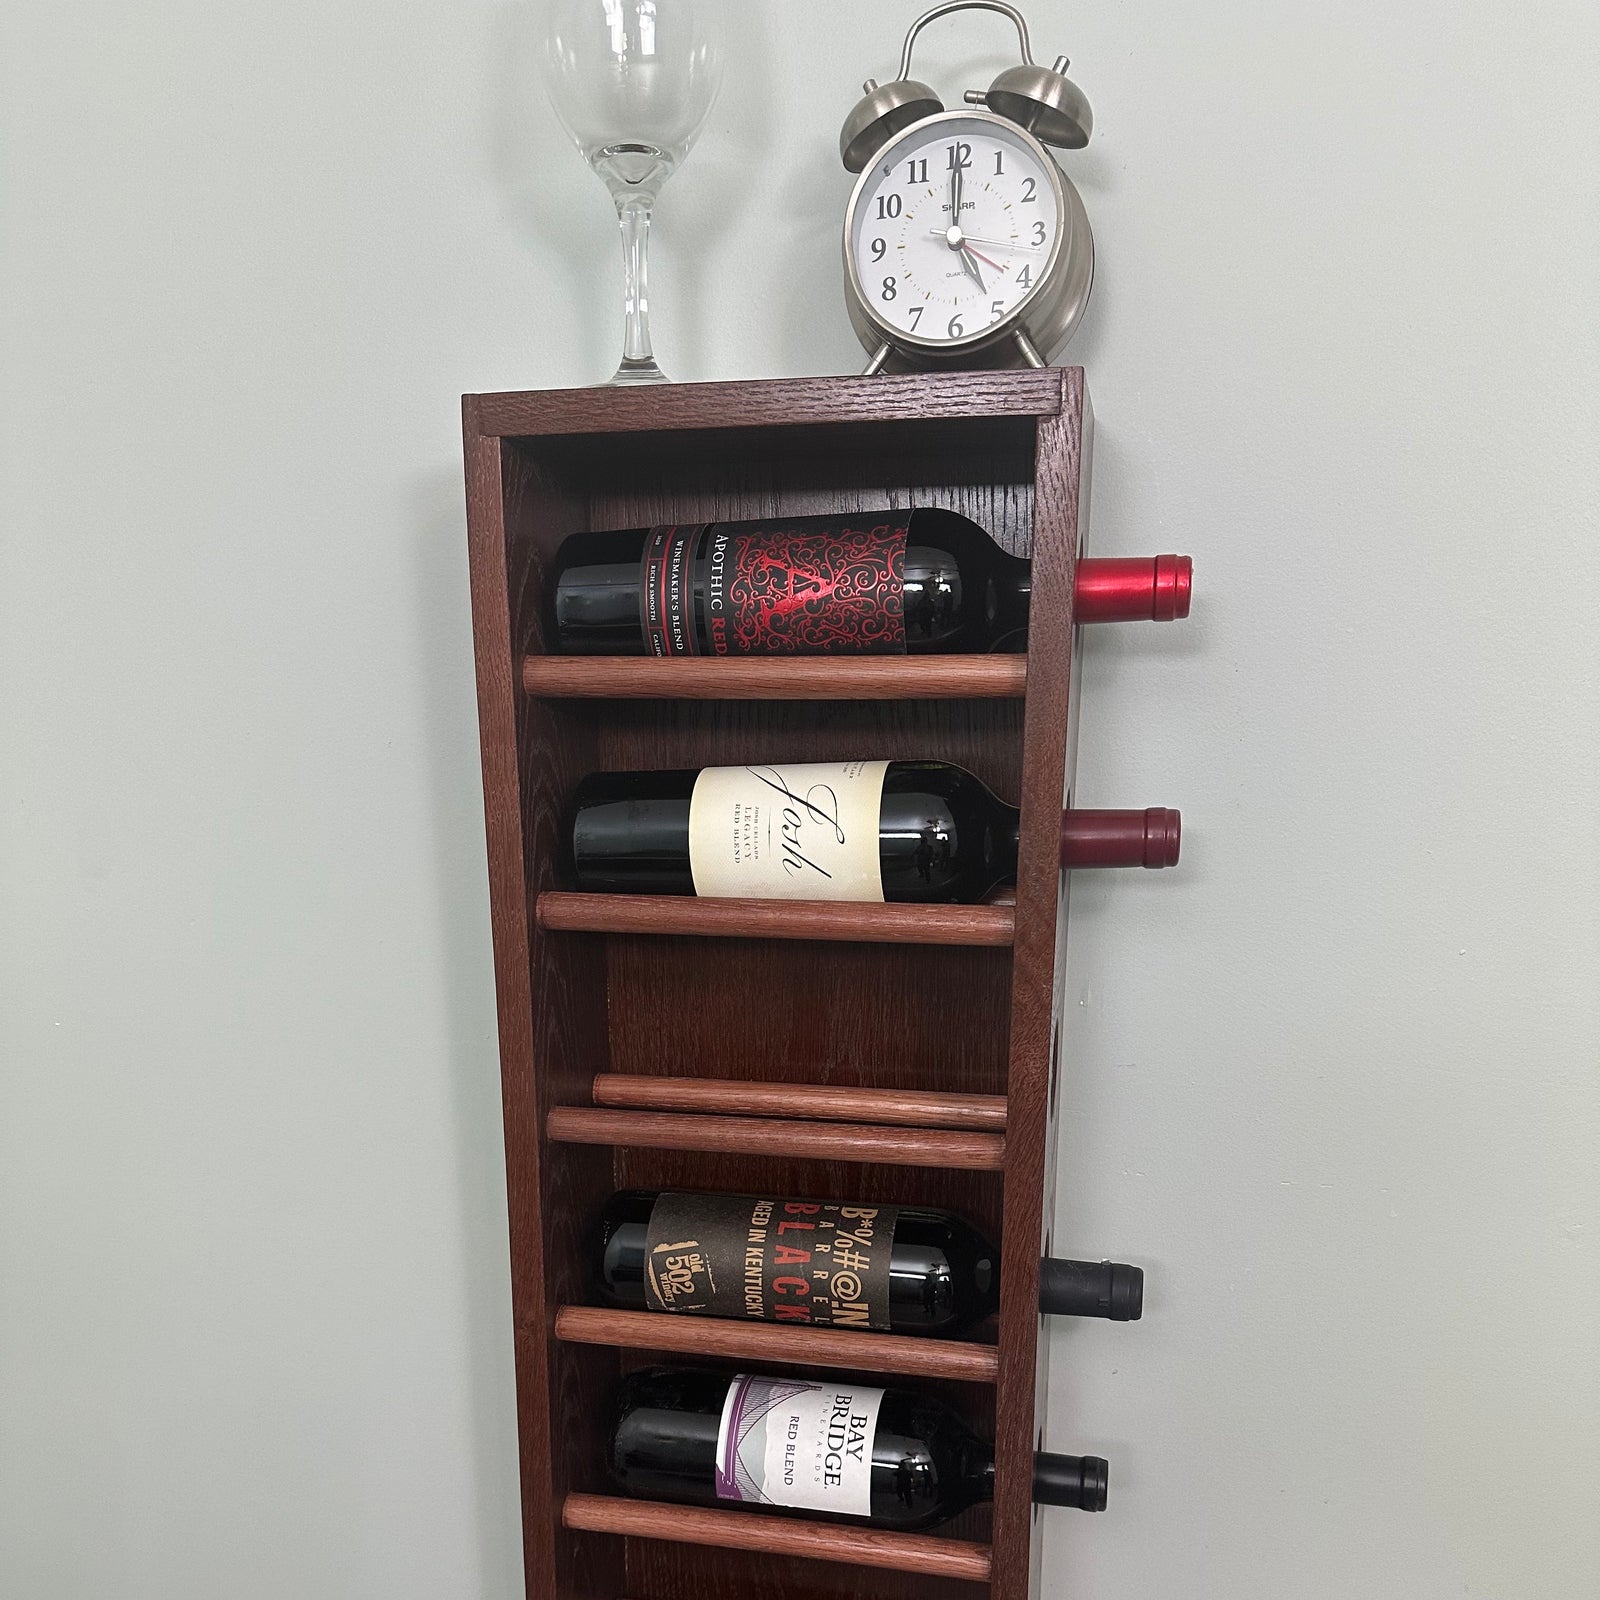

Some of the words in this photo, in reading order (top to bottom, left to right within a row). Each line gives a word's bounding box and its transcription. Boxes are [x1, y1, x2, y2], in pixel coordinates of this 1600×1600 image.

[945, 143, 973, 171] 12
[993, 150, 1005, 176] 1
[907, 158, 930, 185] 11
[1020, 177, 1037, 203] 2
[876, 193, 903, 220] 10
[942, 201, 976, 212] SHRP
[1030, 221, 1046, 247] 3
[871, 237, 887, 263] 9
[881, 276, 897, 301] 8
[1015, 264, 1033, 289] 4
[908, 306, 924, 332] 7
[947, 313, 964, 338] 6
[989, 300, 1005, 325] 5
[671, 540, 684, 611] WINEMAKER'S
[710, 534, 730, 611] APOTHIC
[672, 615, 684, 650] BLEND
[711, 617, 728, 655] RED
[743, 807, 752, 861] LEGACY
[745, 766, 845, 879] Josh
[733, 829, 741, 864] BLEND
[751, 1200, 775, 1226] AGED
[747, 1228, 767, 1243] IN
[689, 1253, 705, 1273] old
[772, 1202, 821, 1320] BLACK
[813, 1205, 840, 1322] BARREL
[660, 1272, 676, 1303] winery
[665, 1255, 695, 1295] 502
[744, 1246, 765, 1318] KENTUCKY
[788, 1416, 800, 1440] RED
[813, 1394, 831, 1483] VINEYARDS
[846, 1414, 868, 1464] BAY
[784, 1444, 796, 1486] BLEND
